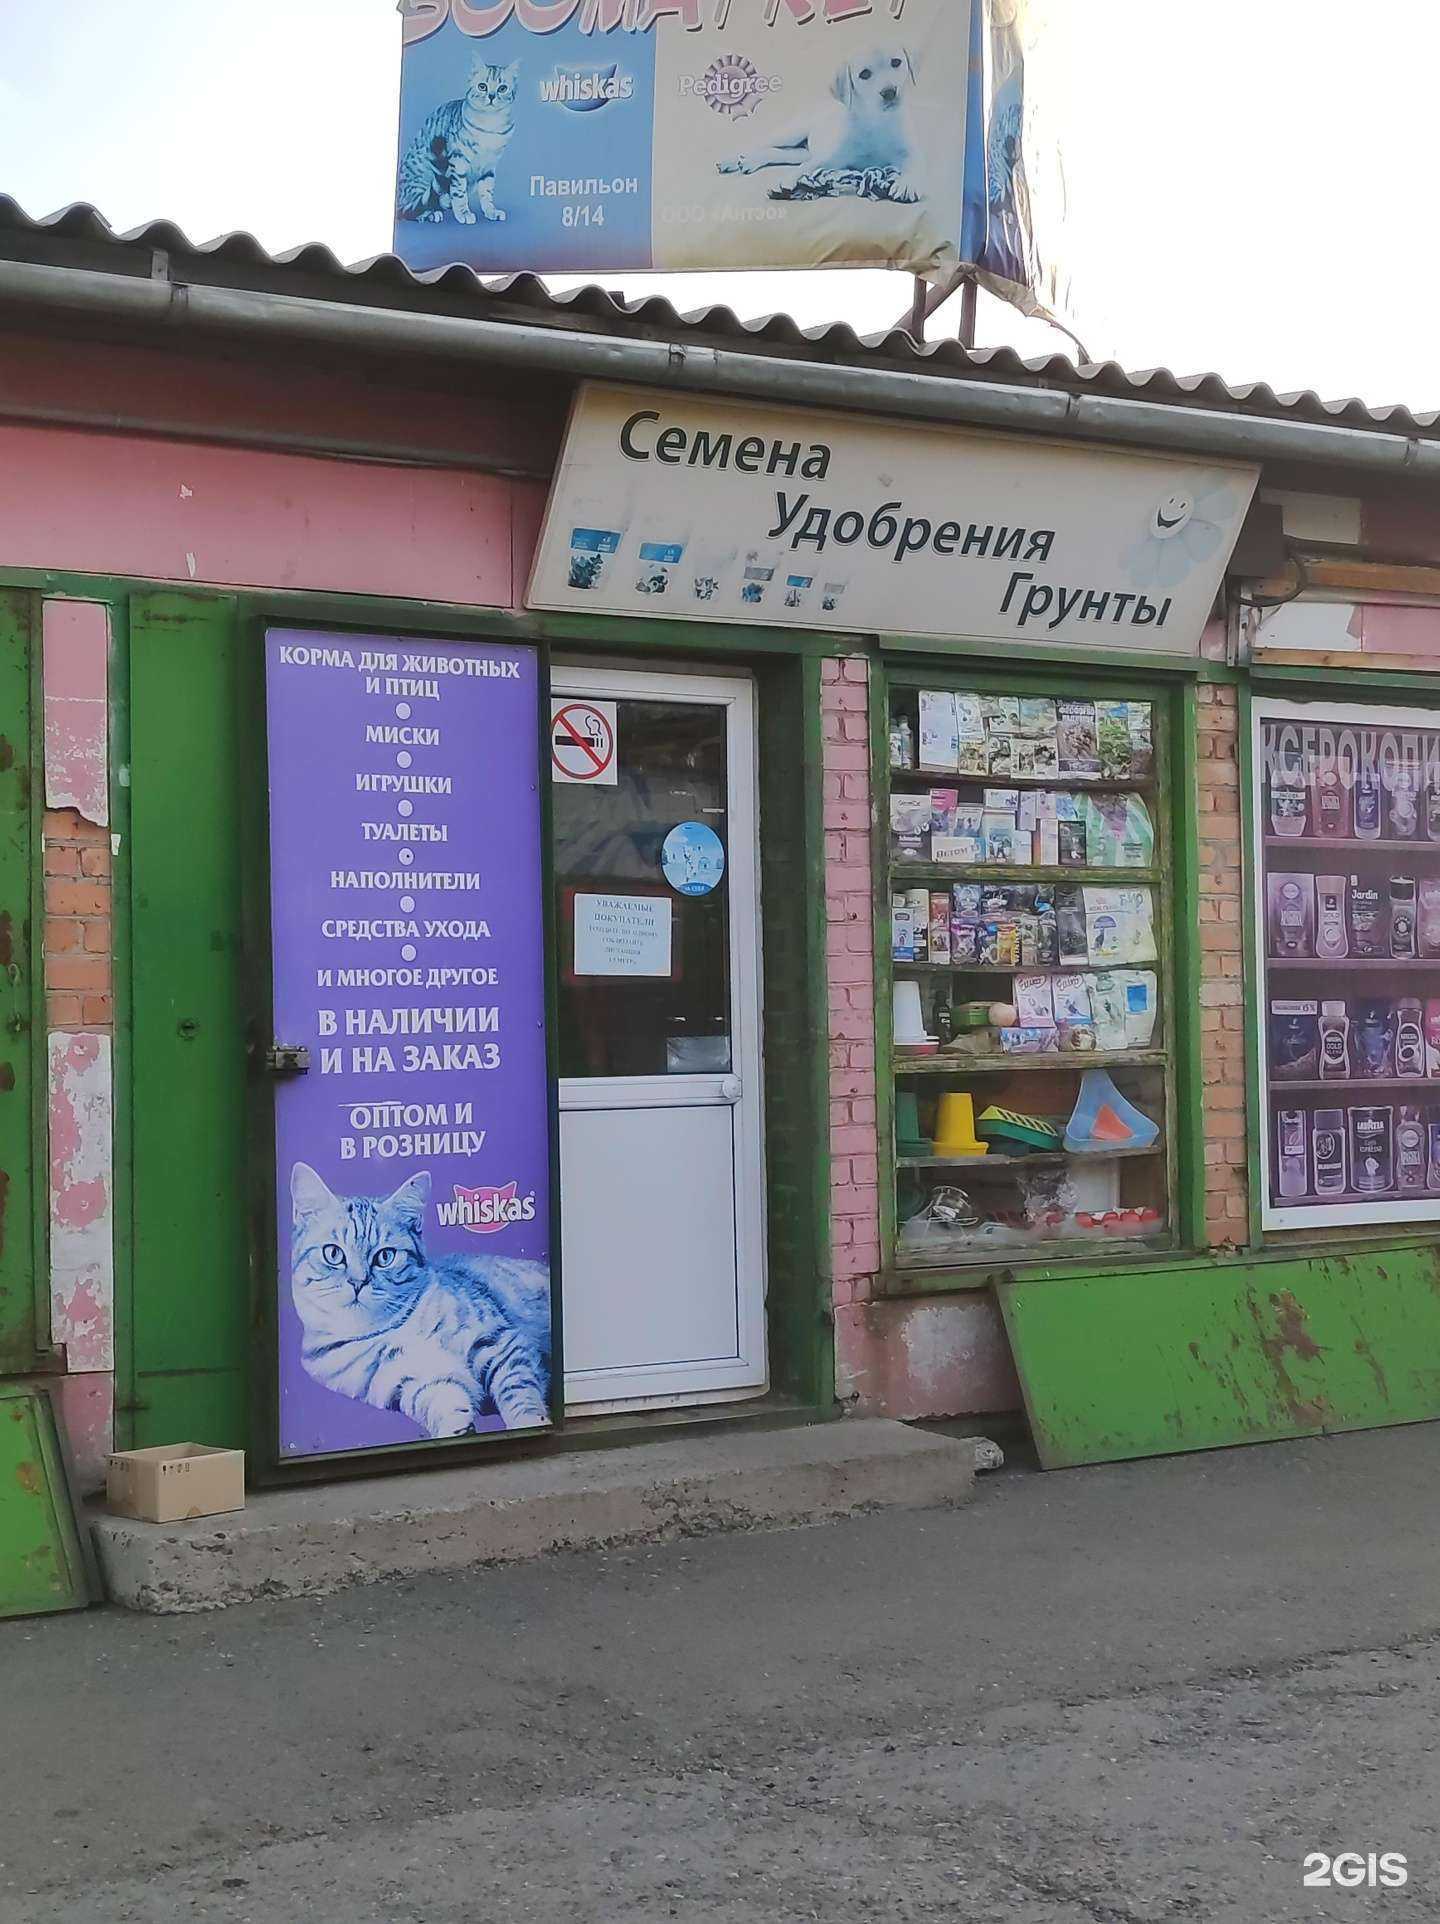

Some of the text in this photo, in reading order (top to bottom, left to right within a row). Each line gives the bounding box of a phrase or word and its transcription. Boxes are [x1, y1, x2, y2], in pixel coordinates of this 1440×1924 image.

[539, 71, 634, 102] whiskas
[677, 72, 784, 98] Pedigree
[530, 175, 638, 197] Павильон
[561, 204, 605, 228] 8/14
[617, 410, 833, 480] Семена
[767, 490, 1057, 563] Удобрения
[998, 571, 1173, 629] Грунты
[279, 646, 521, 680] КОРМА ДЛЯ ЖИВОТНЫХ
[365, 676, 441, 701] И ПТИЦ
[365, 724, 440, 746] МИСКИ
[355, 773, 452, 795] ИГРУШКИ
[361, 822, 449, 842] ТУАЛЕТЫ
[330, 870, 481, 891] НАПОЛНИТЕЛИ
[1351, 889, 1379, 901] Jardin
[321, 919, 492, 941] СРЕДСТВА УХОДА
[317, 967, 499, 989] И МНОГОЕ ДРУГОЕ
[317, 1006, 500, 1036] В НАЛИЧИИ
[319, 1042, 501, 1075] И НА ЗАКАЗ
[349, 1102, 473, 1130] ОПТОМ И
[339, 1131, 486, 1160] В РОЗНИЦУ
[436, 1191, 536, 1227] whiskas
